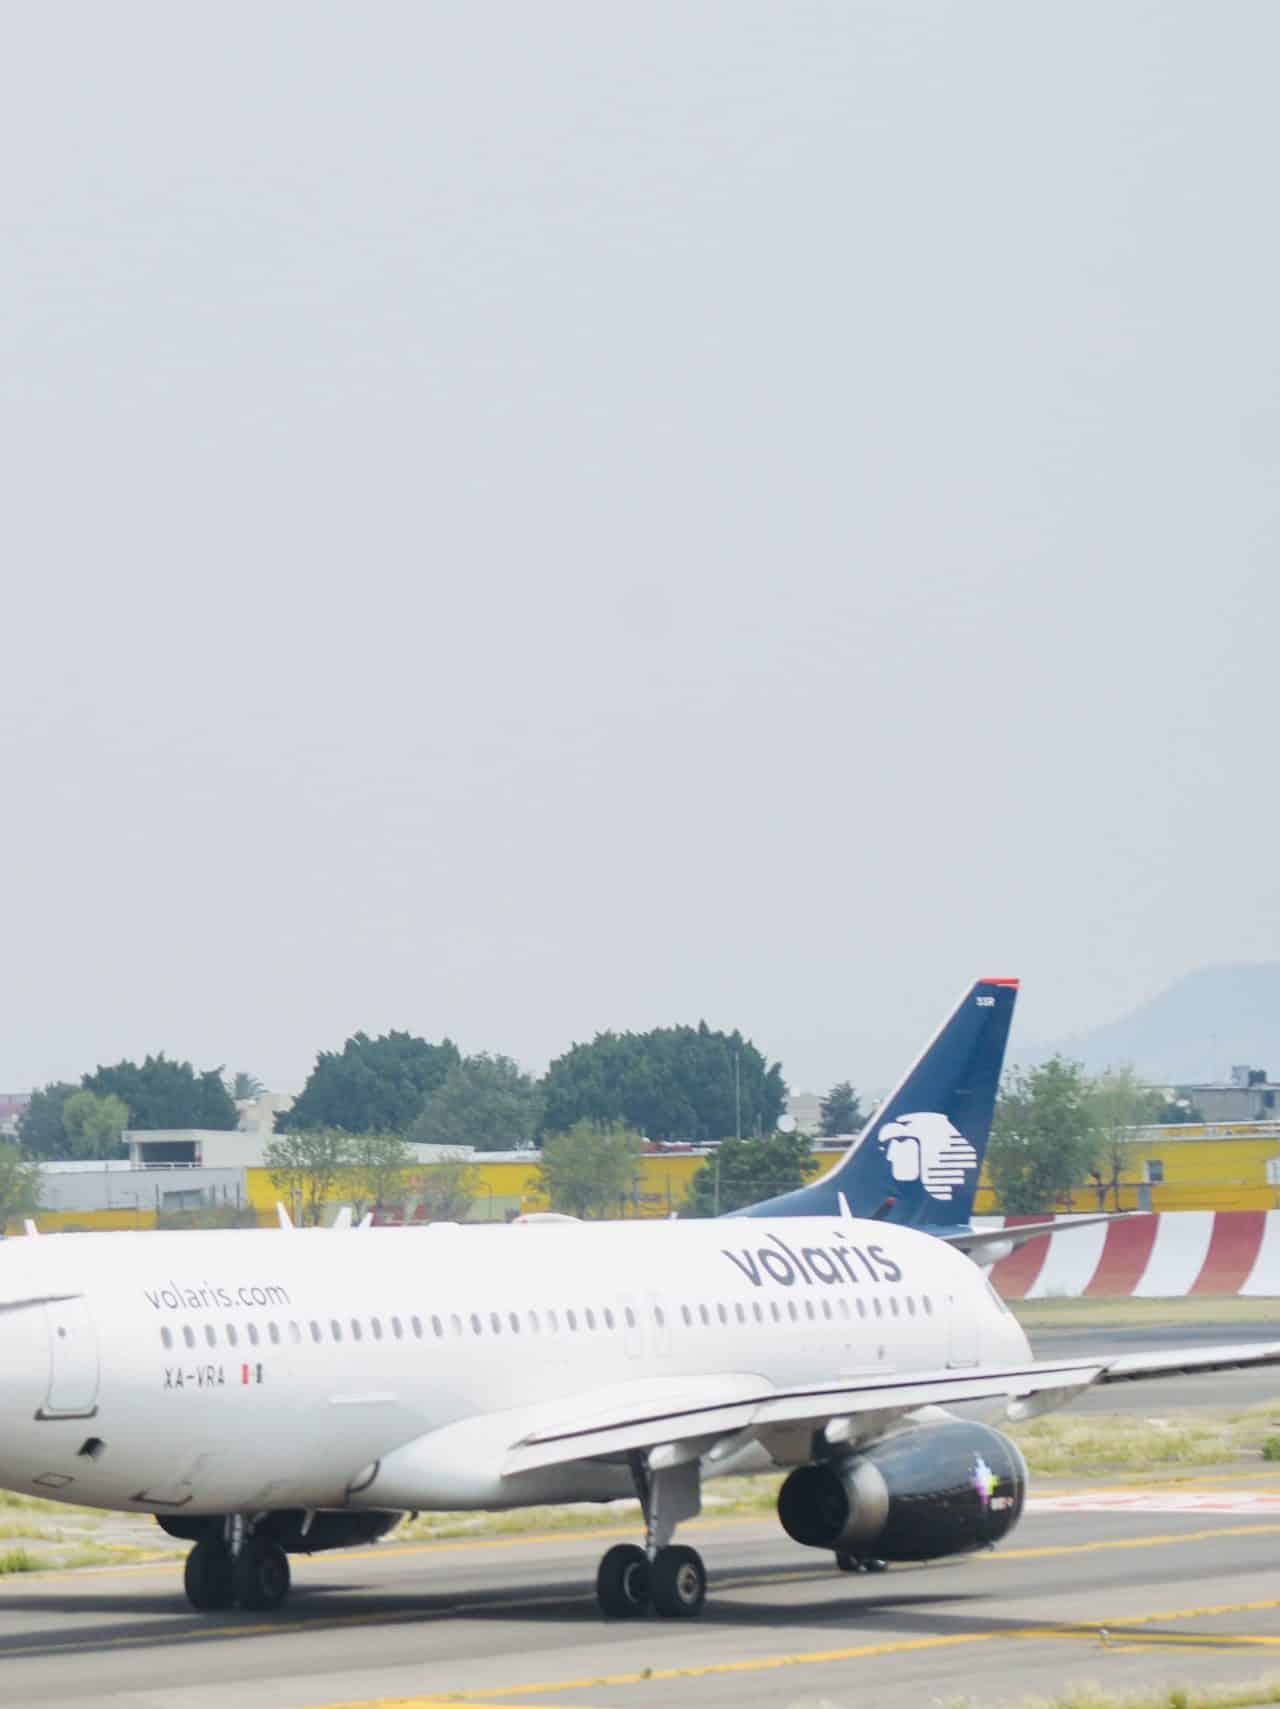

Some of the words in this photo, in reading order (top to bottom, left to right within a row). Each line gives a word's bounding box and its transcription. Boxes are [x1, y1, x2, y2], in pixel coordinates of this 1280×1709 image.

[720, 1231, 902, 1287] volaris
[144, 1280, 291, 1309] volaris.com
[164, 1365, 225, 1389] XA-VRA
